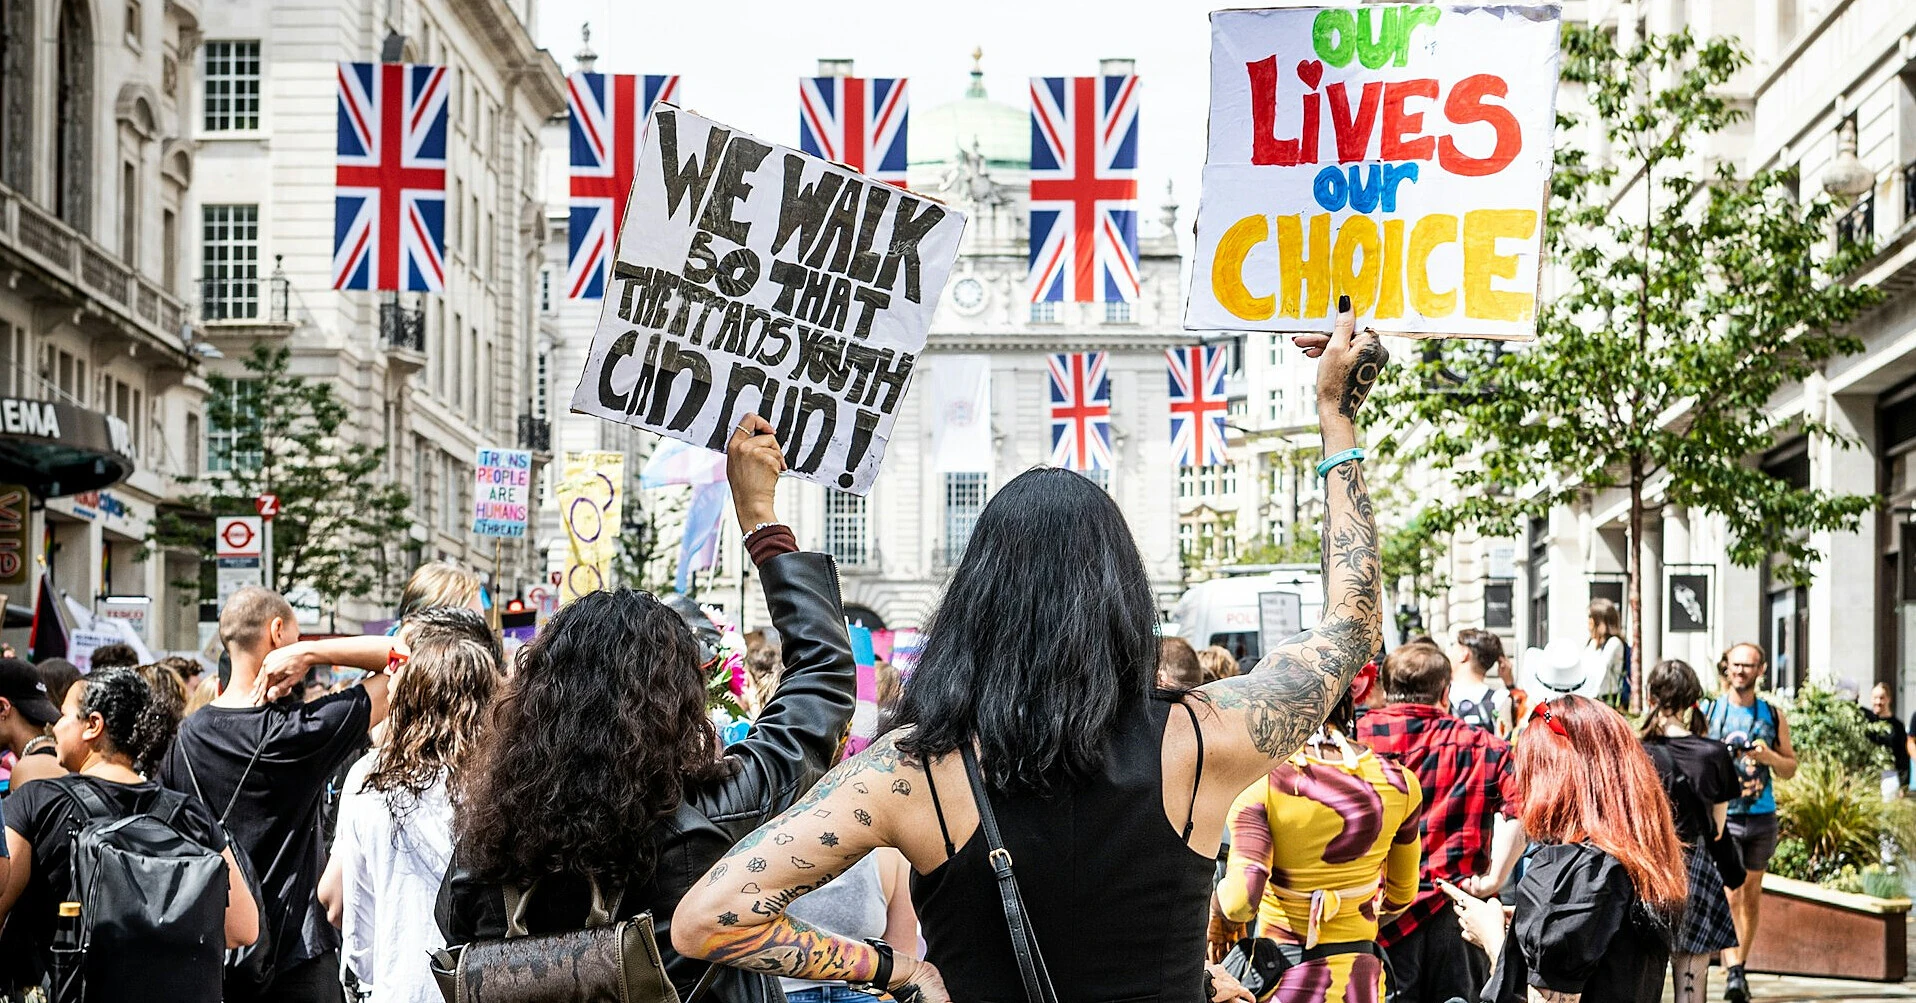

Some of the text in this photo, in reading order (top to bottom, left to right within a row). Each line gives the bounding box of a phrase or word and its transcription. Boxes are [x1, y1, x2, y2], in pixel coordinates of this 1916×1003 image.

[655, 110, 945, 303] WE WALK
[1313, 162, 1419, 214] our
[1211, 208, 1537, 322] CHOICE
[681, 231, 891, 340] SO THAT
[614, 261, 682, 330] THE
[788, 325, 914, 415] YOUTH
[478, 467, 527, 486] PEOPLE
[481, 450, 528, 468] TRANS
[260, 494, 277, 516] Z
[476, 502, 526, 521] HUMANS
[489, 486, 516, 503] ARE
